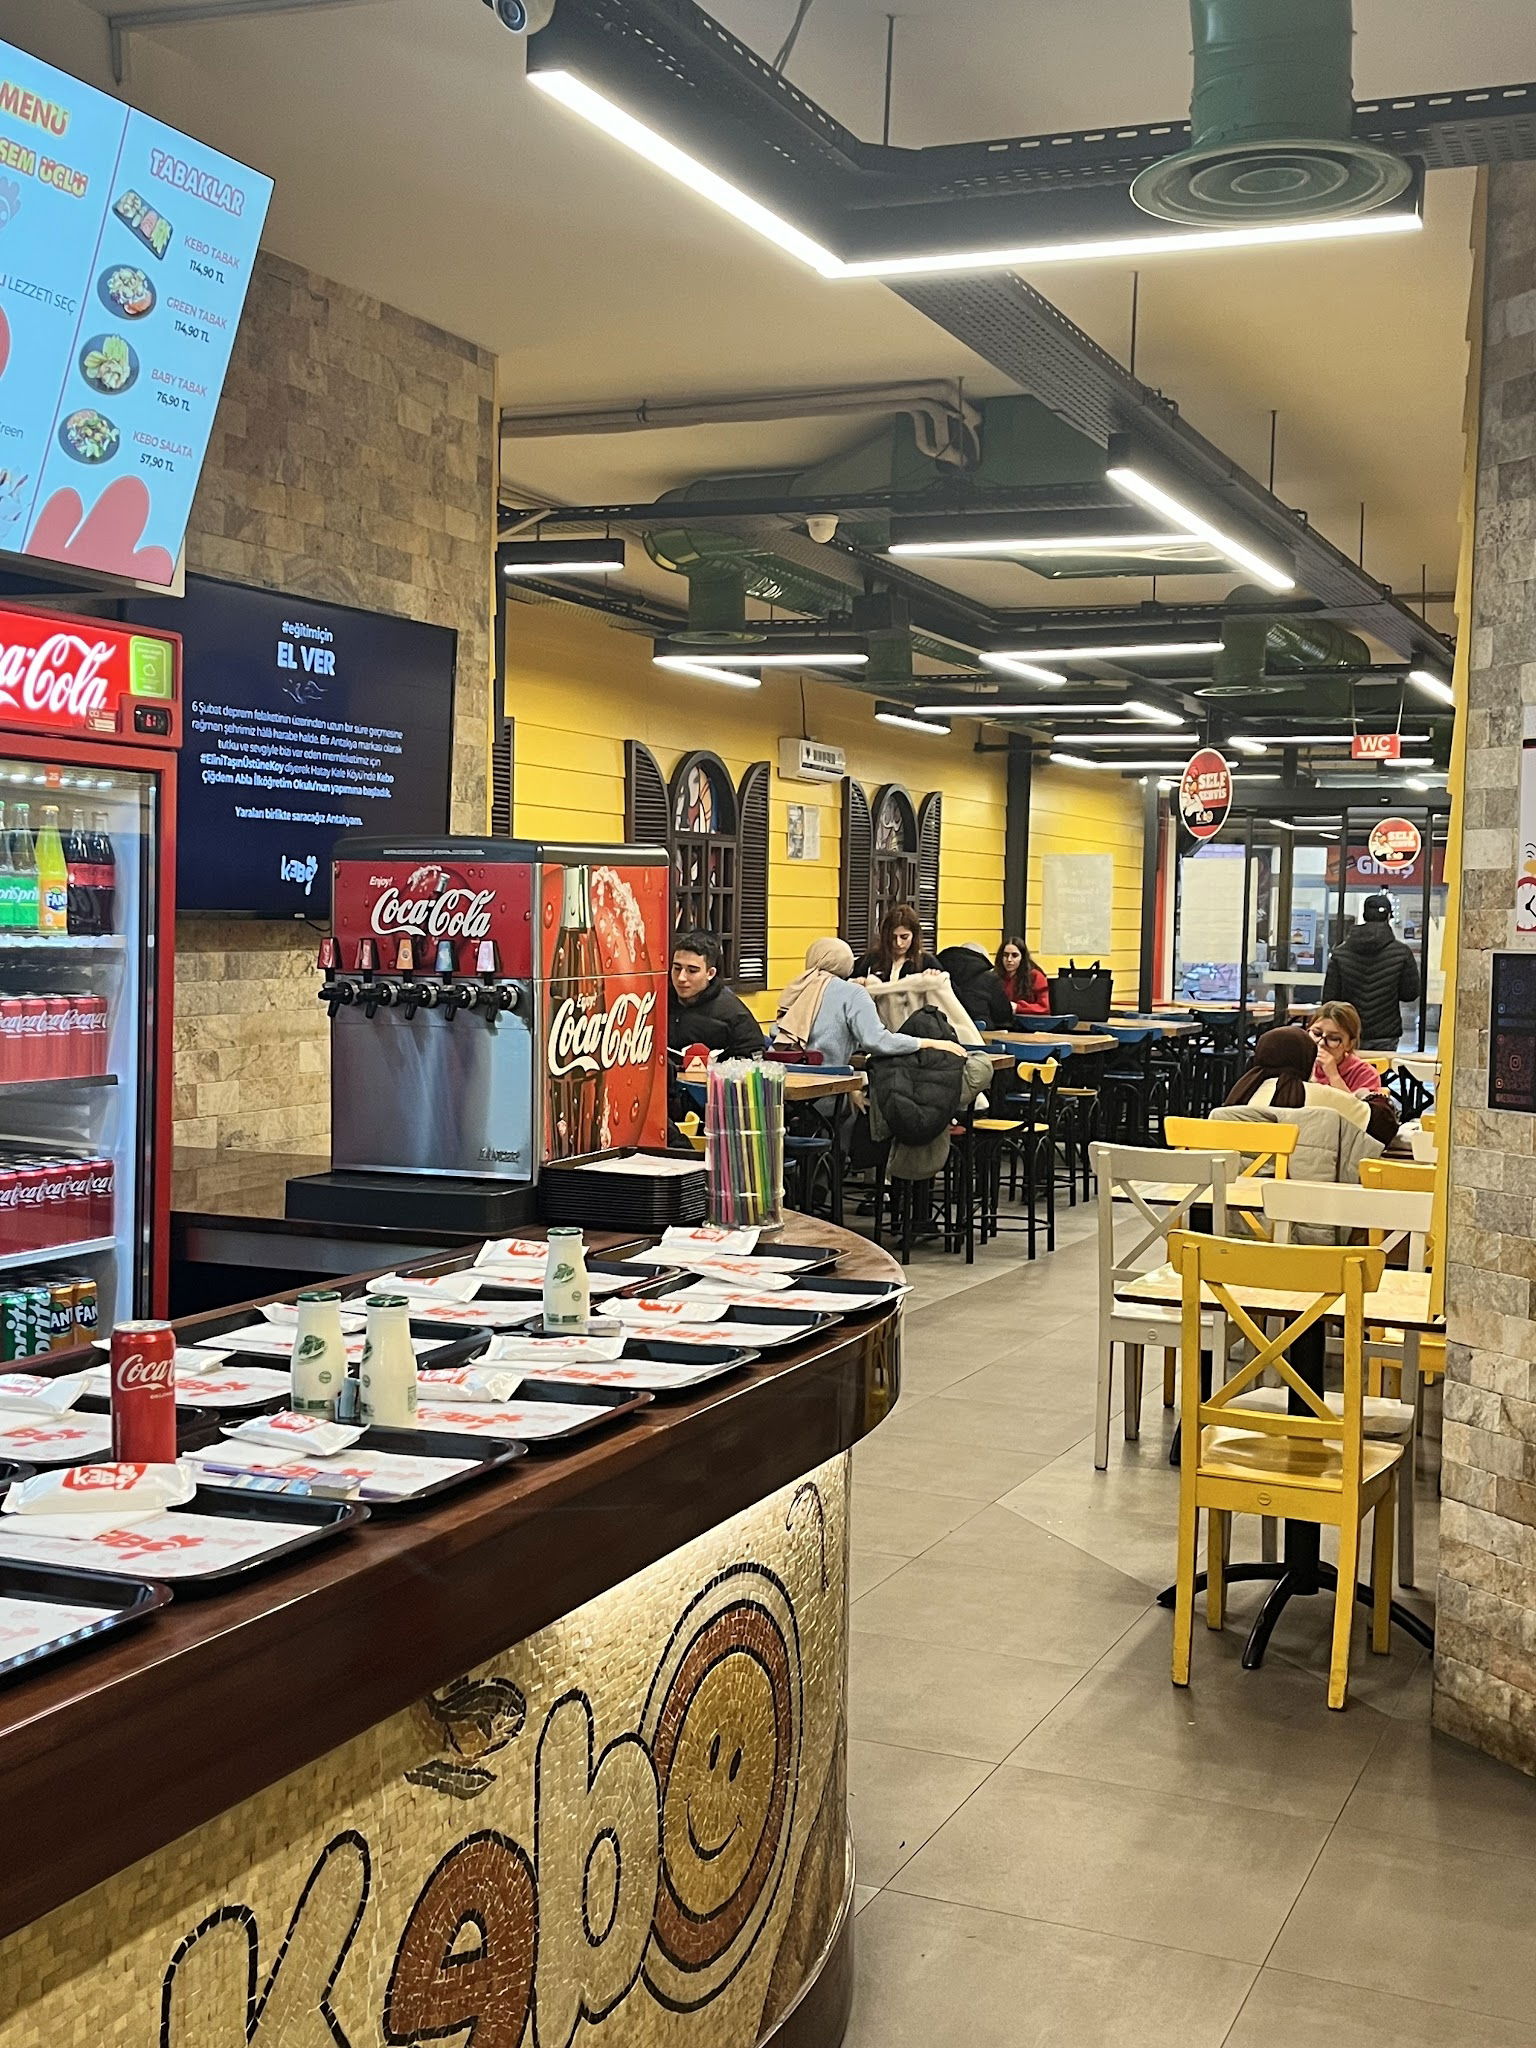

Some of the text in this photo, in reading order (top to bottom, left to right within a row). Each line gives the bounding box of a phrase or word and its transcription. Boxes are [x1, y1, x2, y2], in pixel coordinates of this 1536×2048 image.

[0, 82, 68, 136] MENÜ
[151, 148, 245, 217] TABAKLAR
[184, 235, 241, 269] KEBO TABAK
[215, 272, 225, 284] TL
[8, 275, 53, 305] LEZZETİ
[54, 294, 77, 316] SEÇ
[166, 296, 228, 329] GREEN TABAK
[199, 329, 210, 343] TL
[151, 368, 208, 397] BABY TABAK
[157, 391, 191, 411] 76,90 TL
[0, 421, 24, 439] reen
[133, 430, 193, 458] KEBO SALATA
[140, 452, 175, 472] 57,90 TL
[281, 620, 334, 645] #eğitimiçin
[277, 641, 336, 676] EL VER
[192, 700, 198, 712] 6
[198, 701, 222, 716] Şubat
[222, 705, 254, 720] deprem
[192, 719, 224, 733] rağmen
[240, 742, 250, 752] ve
[303, 749, 322, 760] eden
[1360, 735, 1392, 752] WC
[201, 769, 234, 785] Çiğdem
[234, 772, 253, 786] Abla
[310, 764, 331, 779] Hatay
[1198, 771, 1228, 790] SELF
[369, 876, 394, 888] Enjoy!
[371, 887, 496, 938] Coca-Cola
[548, 990, 657, 1076] Coca-Cola
